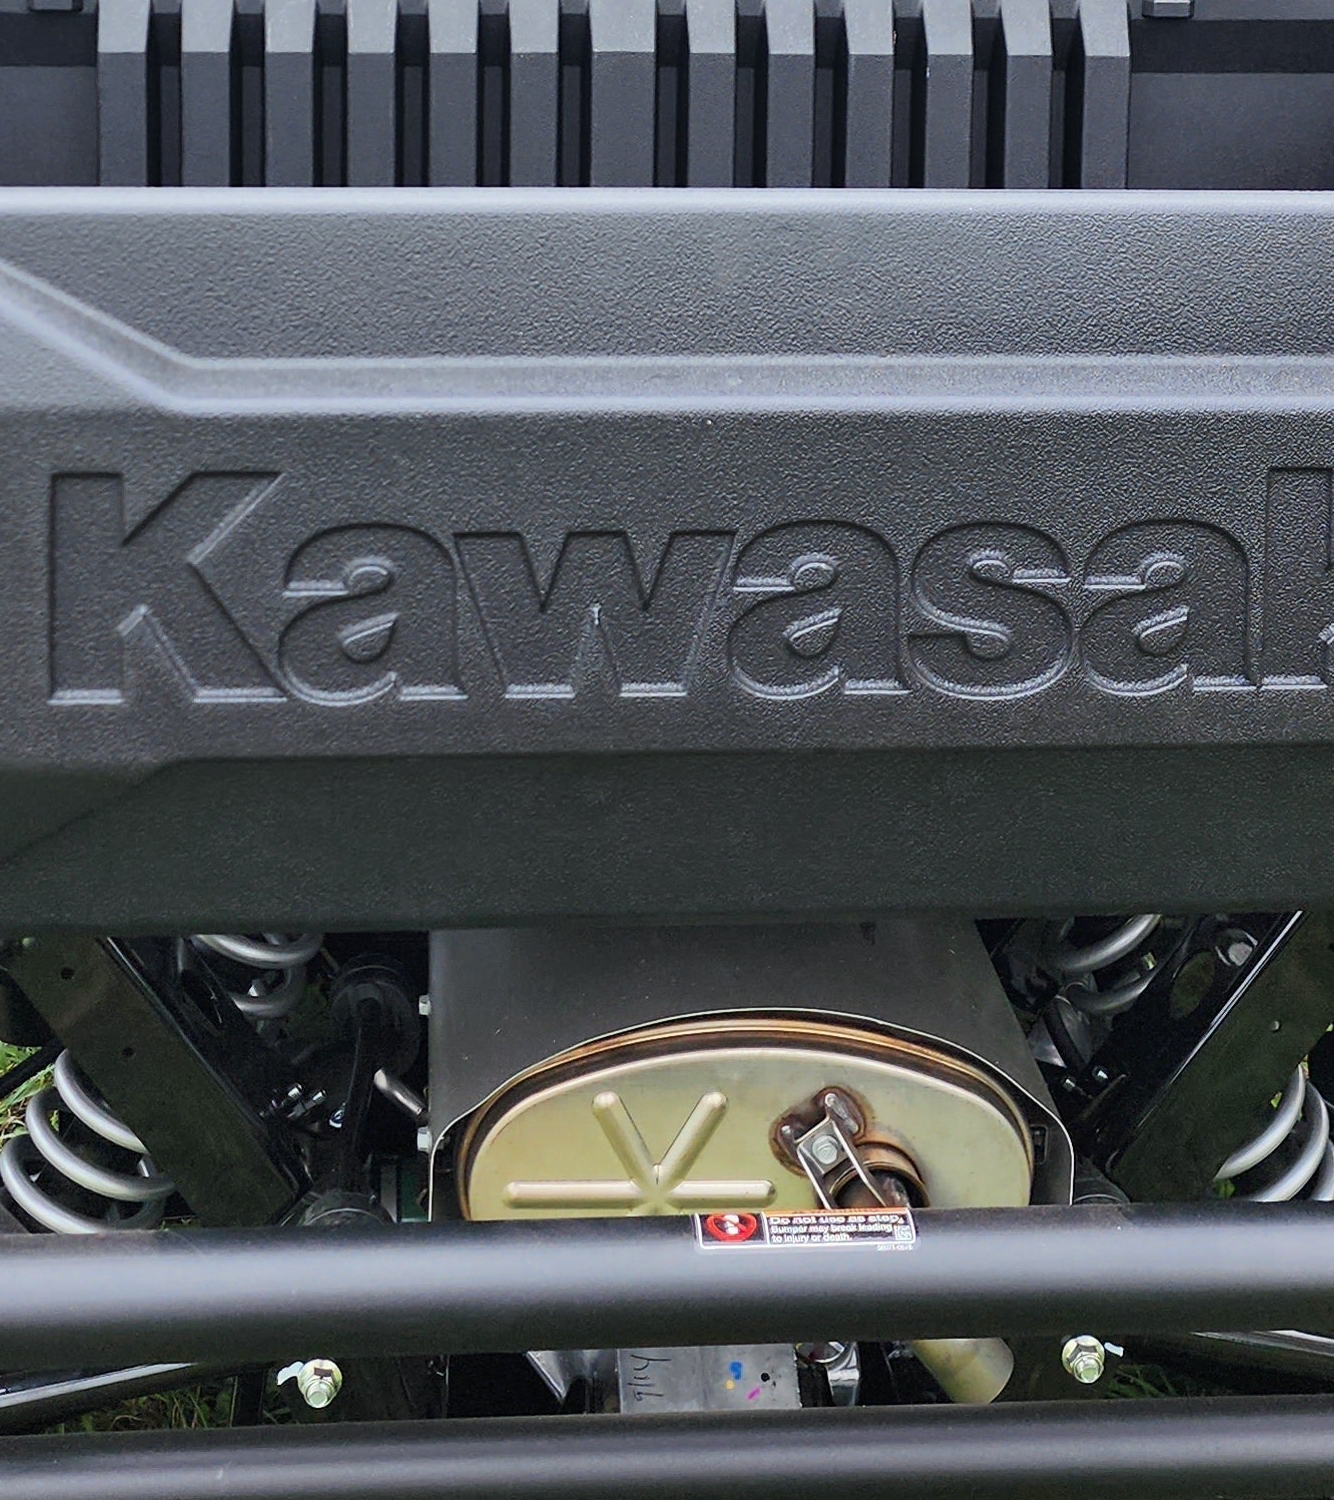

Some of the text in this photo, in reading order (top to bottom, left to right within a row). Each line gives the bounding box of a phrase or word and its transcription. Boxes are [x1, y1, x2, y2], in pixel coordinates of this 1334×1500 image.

[769, 1217, 790, 1225] Do
[793, 1216, 817, 1225] not
[770, 1223, 893, 1234] Bumper may break leading
[771, 1233, 853, 1245] to injury or death.
